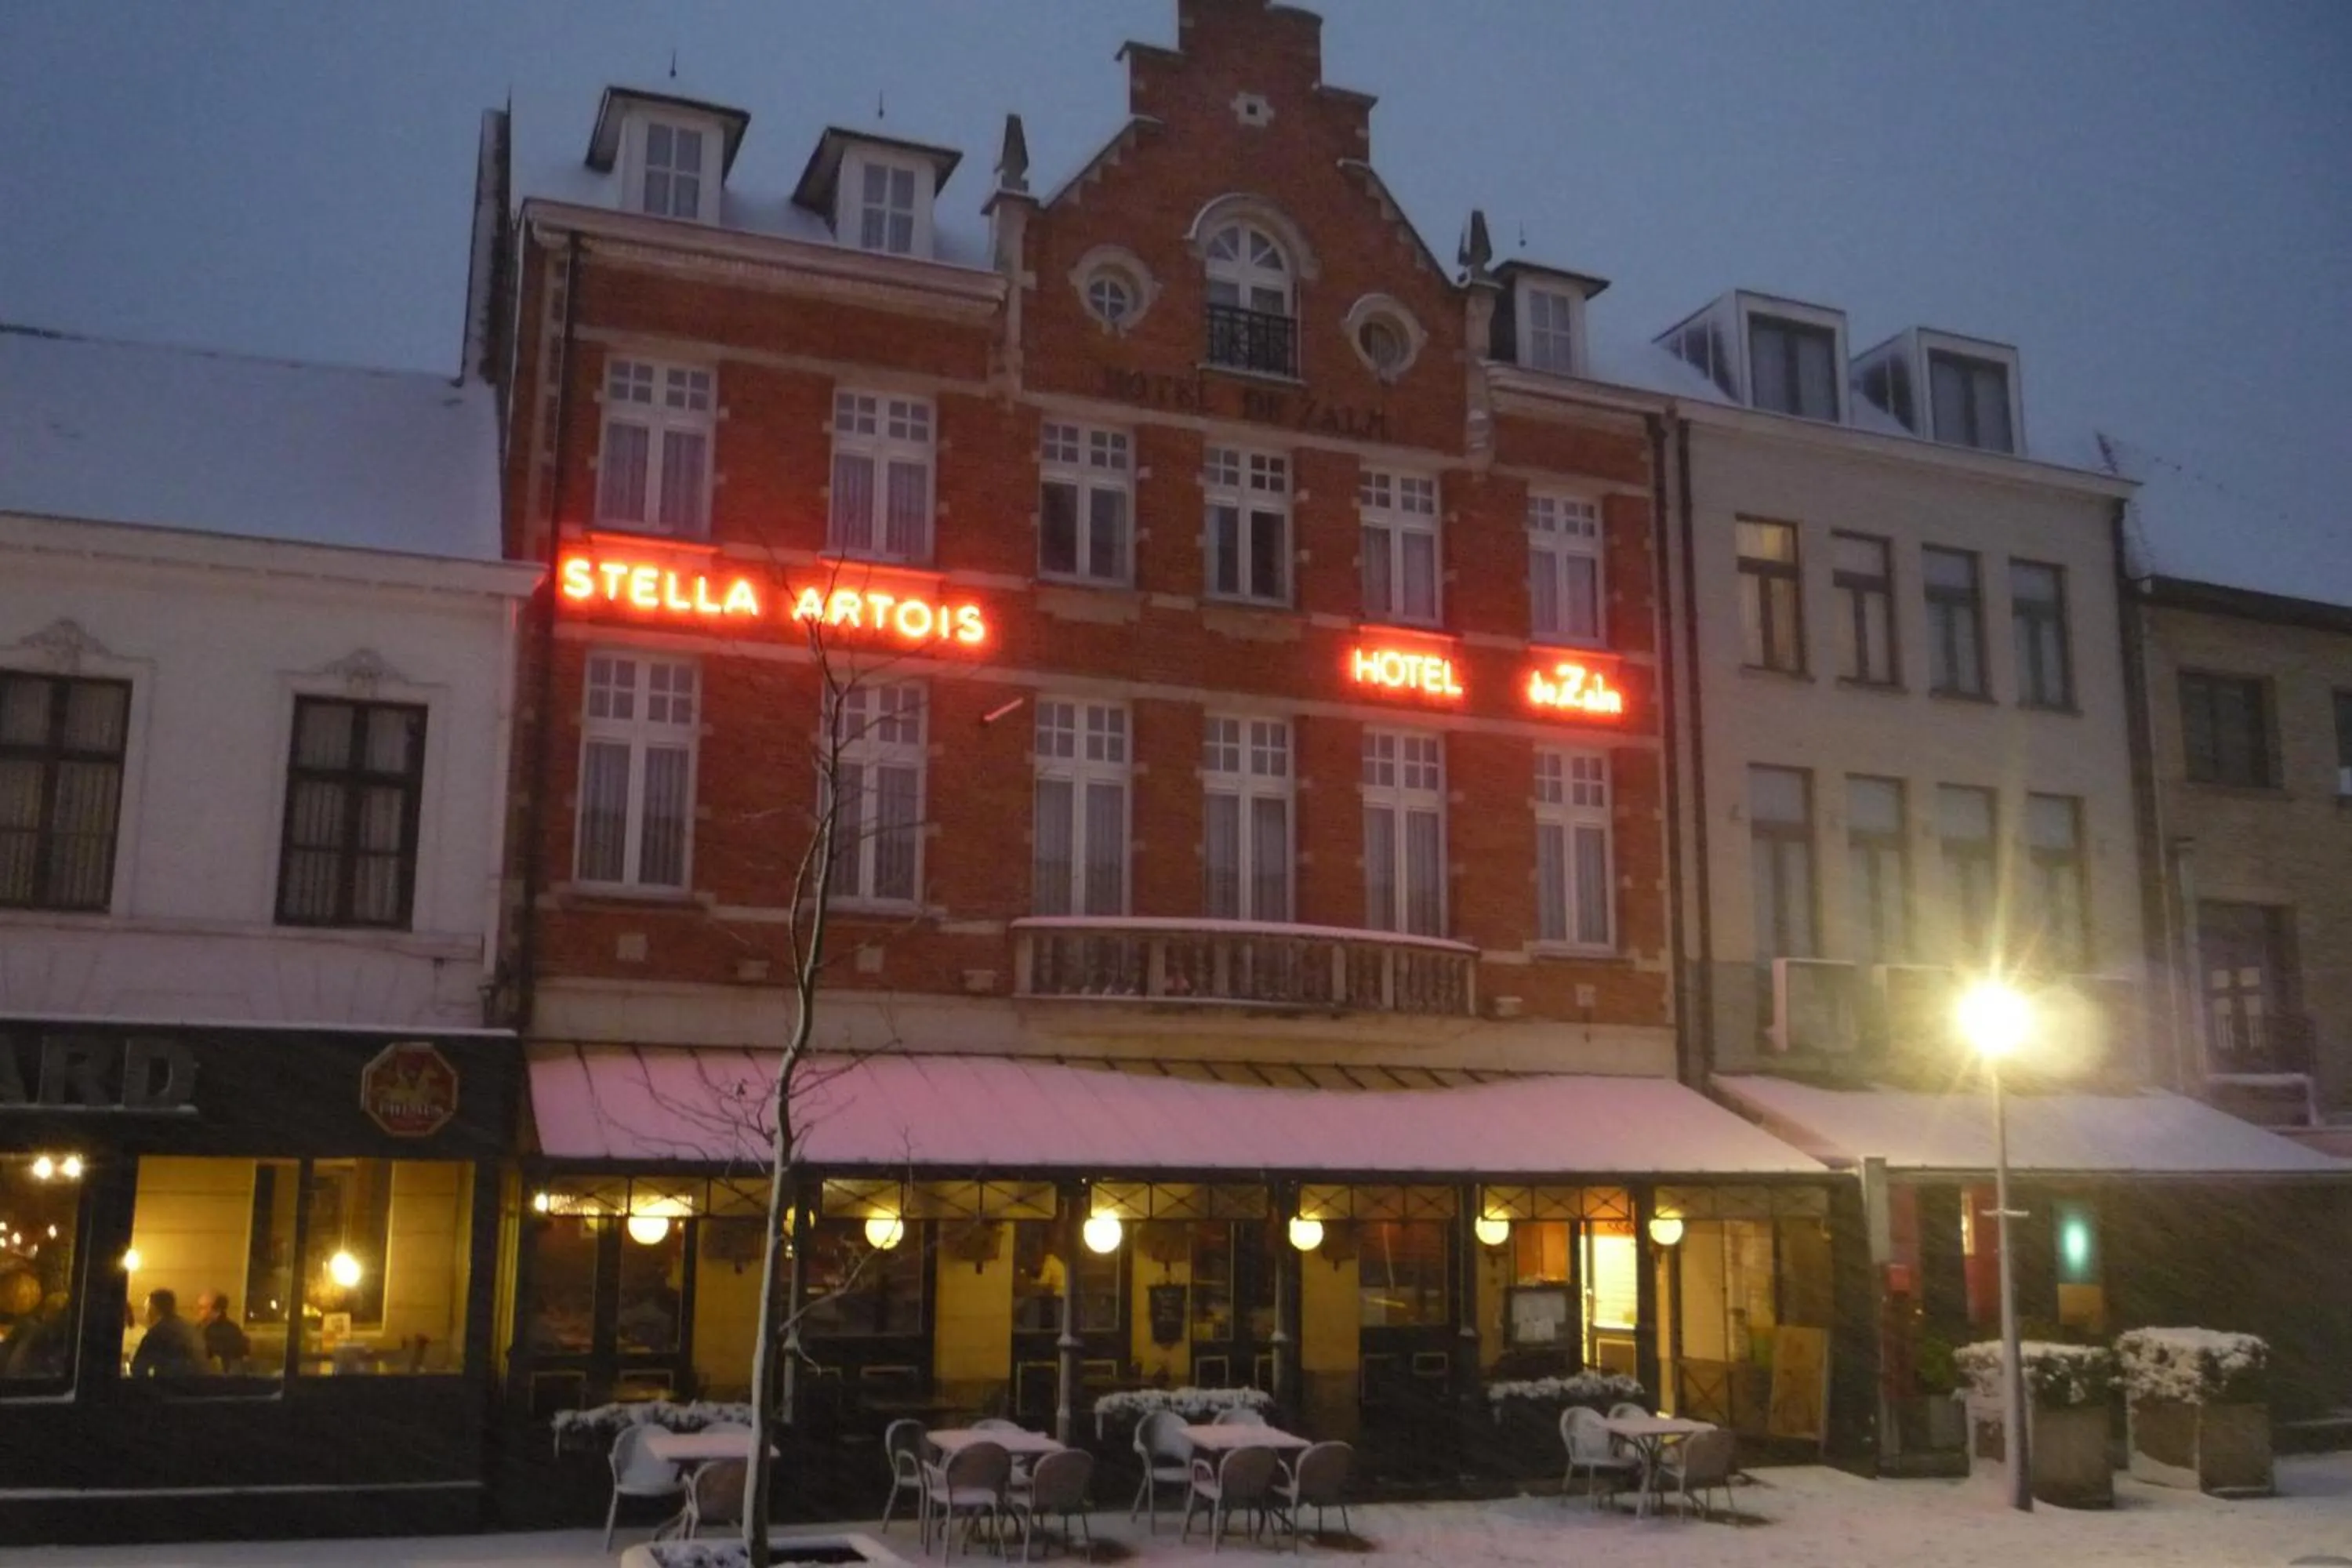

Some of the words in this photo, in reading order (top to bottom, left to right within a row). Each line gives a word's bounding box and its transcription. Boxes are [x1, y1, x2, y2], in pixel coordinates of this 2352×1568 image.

[563, 557, 758, 616] STELLA
[793, 586, 985, 643] ARTOIS
[1354, 648, 1464, 695] HOTEL
